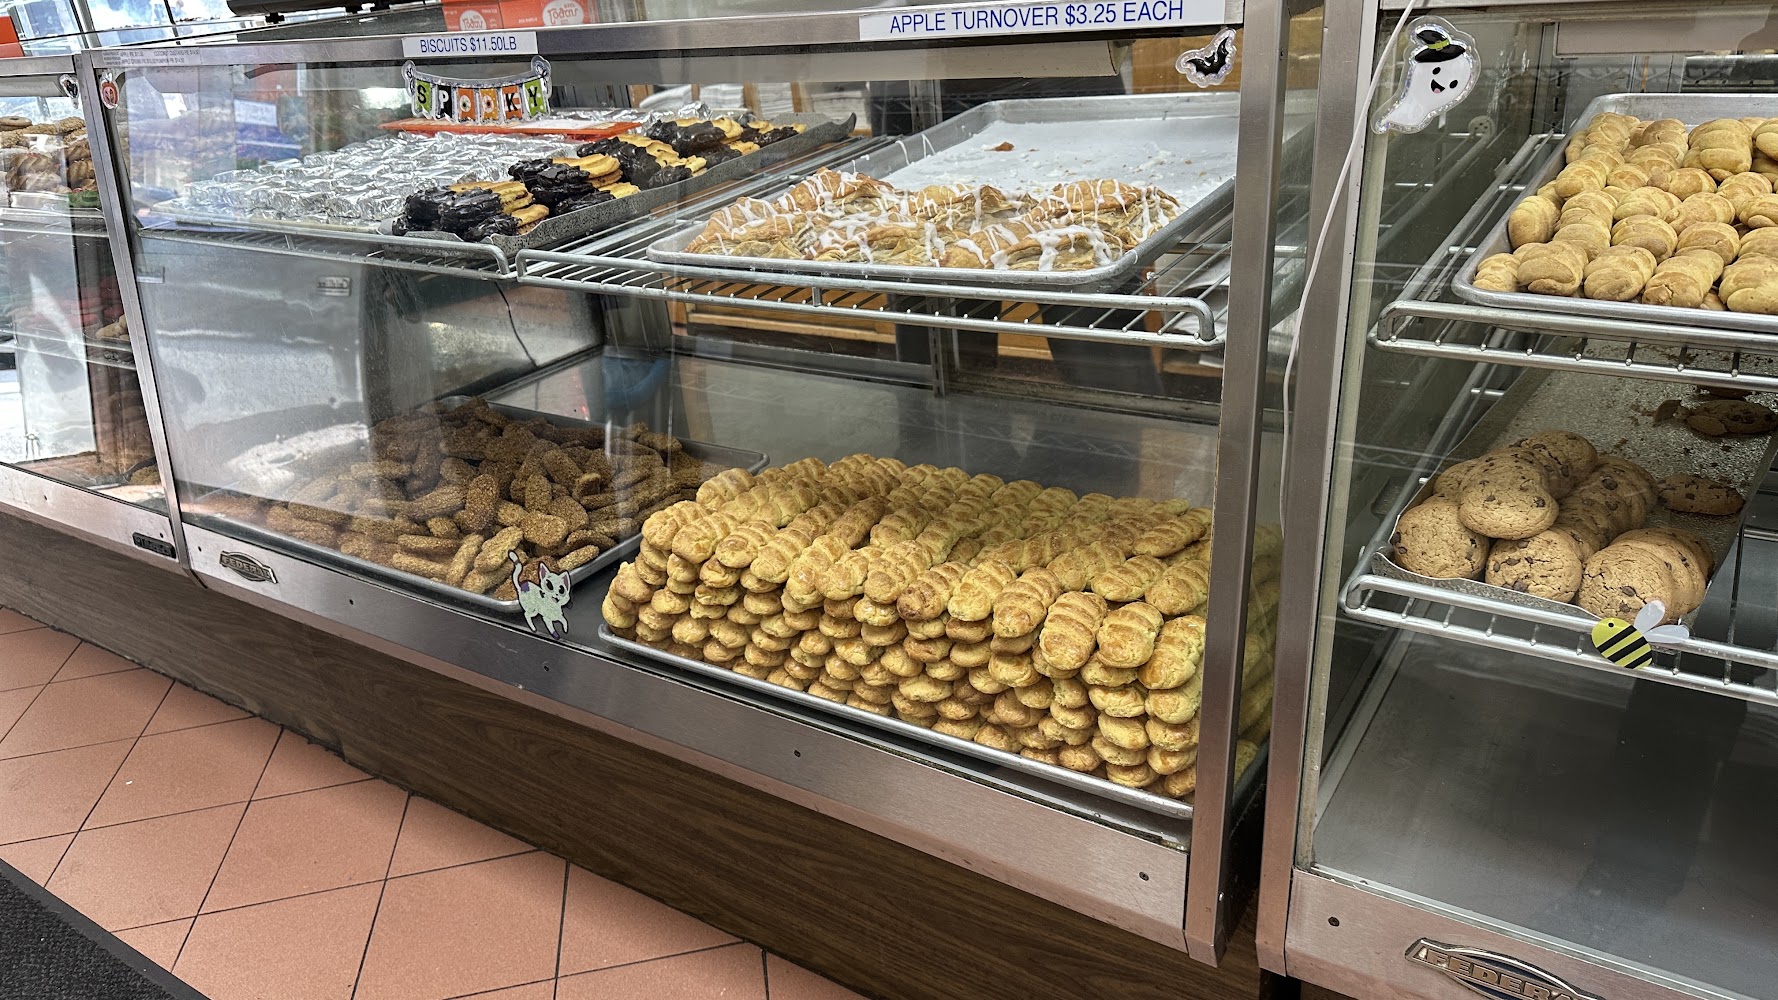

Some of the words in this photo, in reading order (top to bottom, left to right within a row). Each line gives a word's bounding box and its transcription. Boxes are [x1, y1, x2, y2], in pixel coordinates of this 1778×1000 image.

[889, 12, 946, 34] APPLE
[951, 6, 1059, 30] TURNOVER
[1065, 2, 1117, 27] $3.25
[1123, 0, 1184, 22] EACH
[420, 37, 467, 53] BISCUITS
[470, 36, 517, 52] $11.50LB
[416, 84, 539, 112] SPOOKY
[1426, 950, 1573, 1000] FEDER
